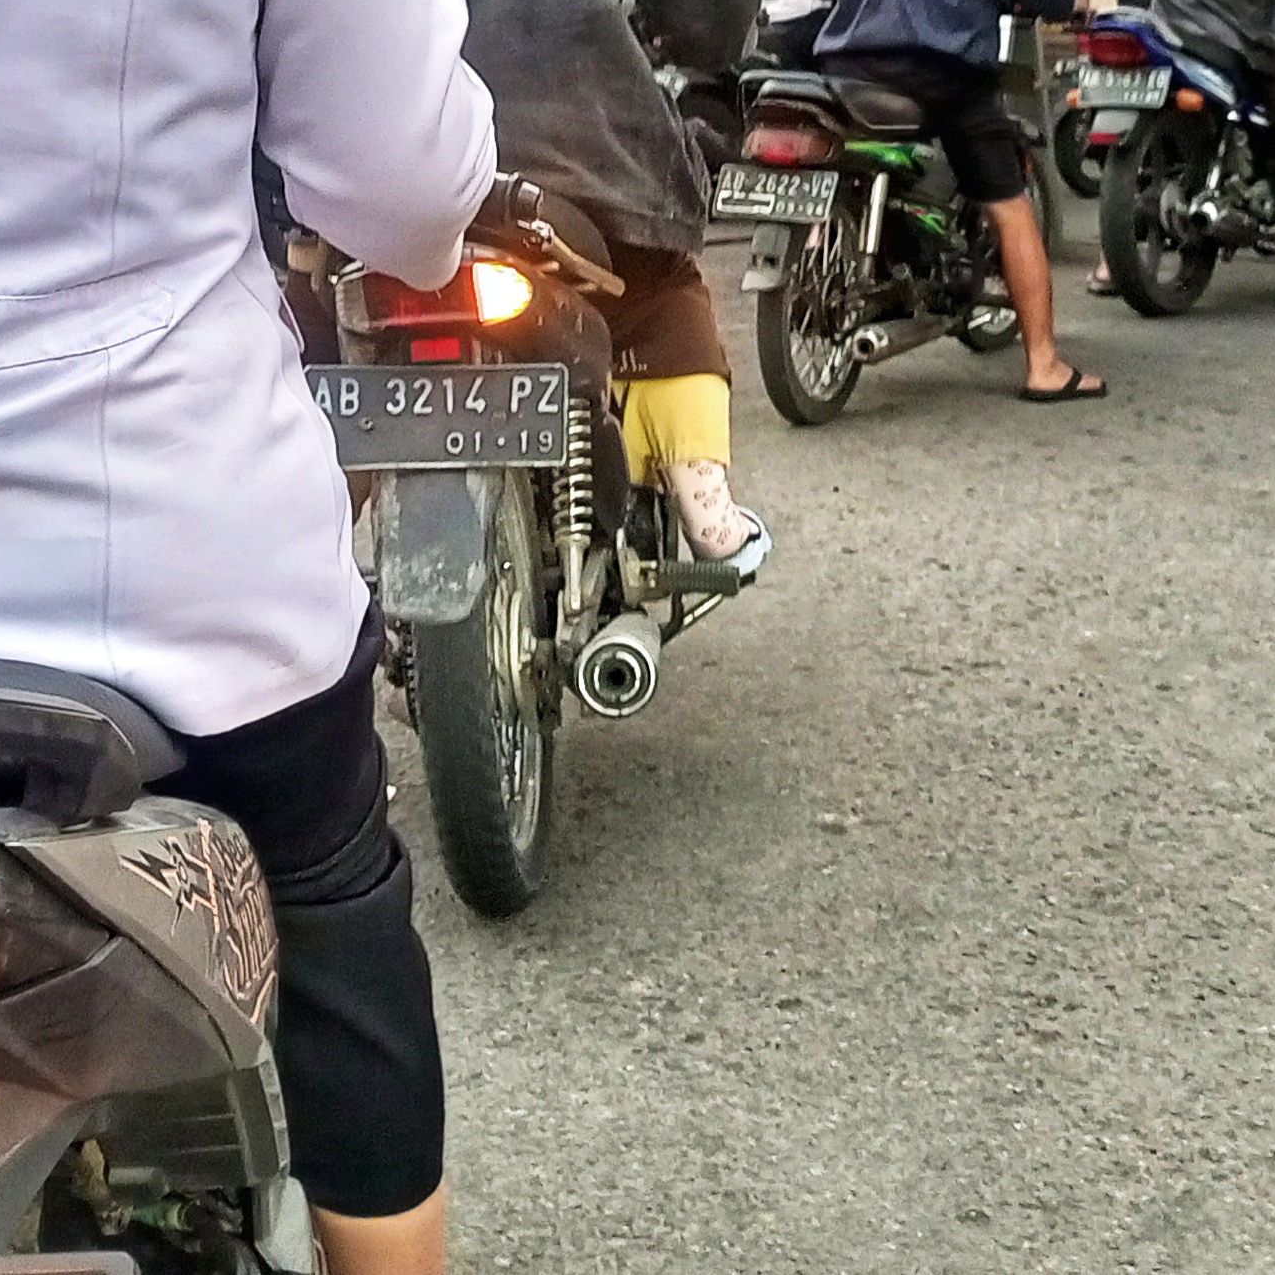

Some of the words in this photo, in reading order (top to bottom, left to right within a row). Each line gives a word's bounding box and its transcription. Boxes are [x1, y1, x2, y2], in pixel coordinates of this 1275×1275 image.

[314, 376, 361, 416] AB
[385, 376, 487, 415] 3214
[510, 375, 560, 414] PZ
